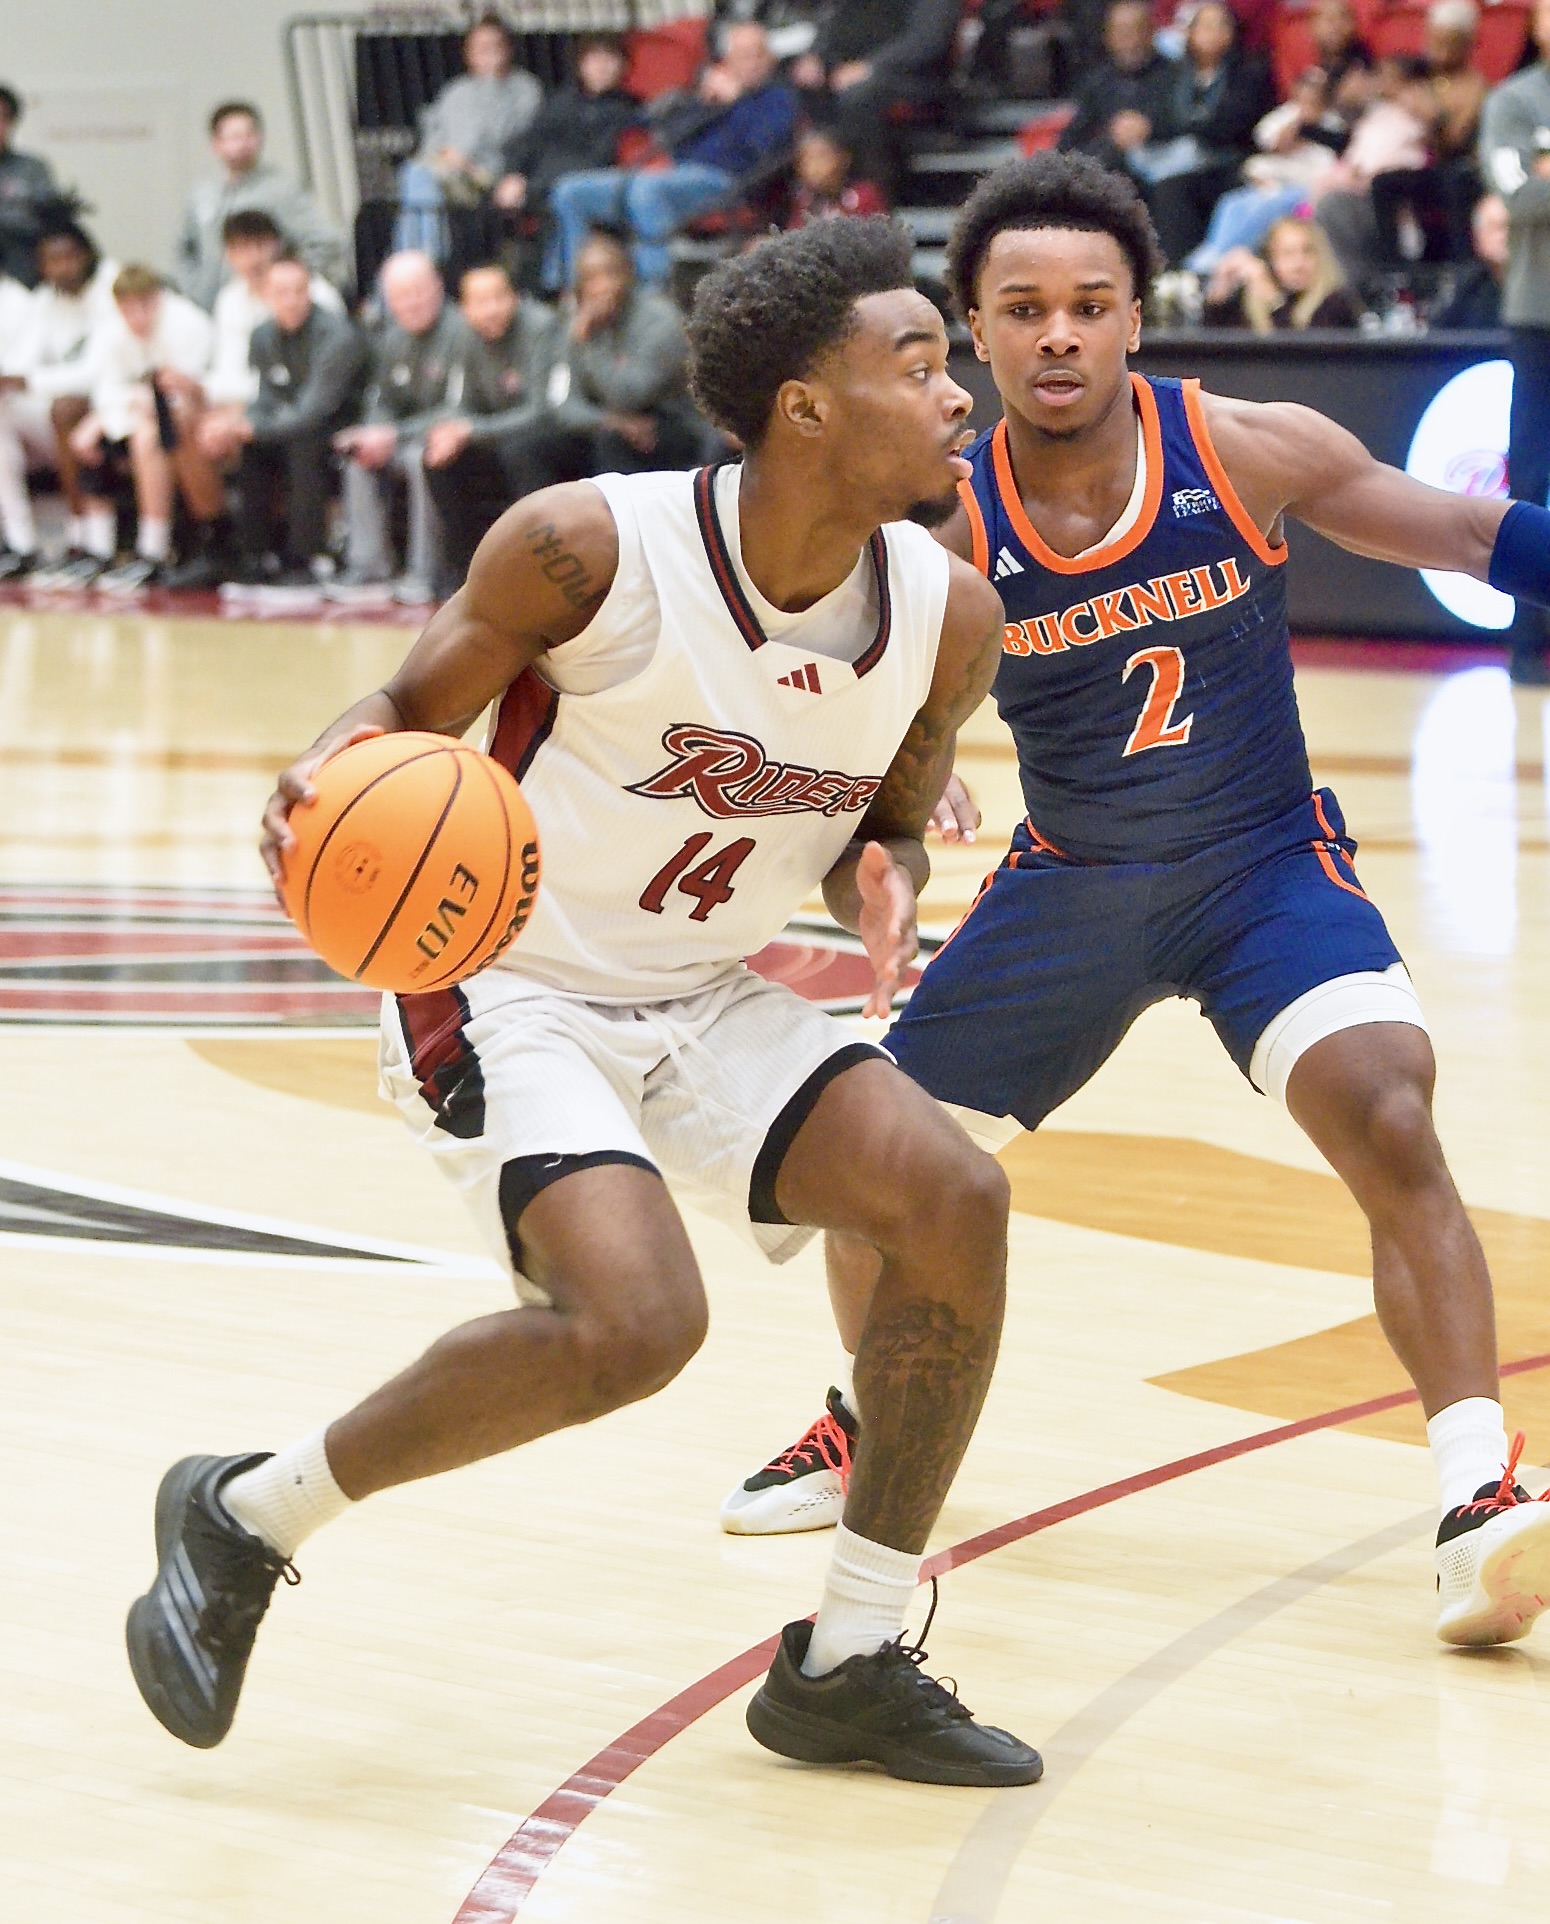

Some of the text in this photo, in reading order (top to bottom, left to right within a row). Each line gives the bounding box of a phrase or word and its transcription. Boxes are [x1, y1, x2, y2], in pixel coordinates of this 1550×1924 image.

[1002, 557, 1251, 657] BUCKNELL
[1121, 645, 1195, 758] 2
[415, 861, 480, 961] EVO
[638, 831, 757, 923] 14
